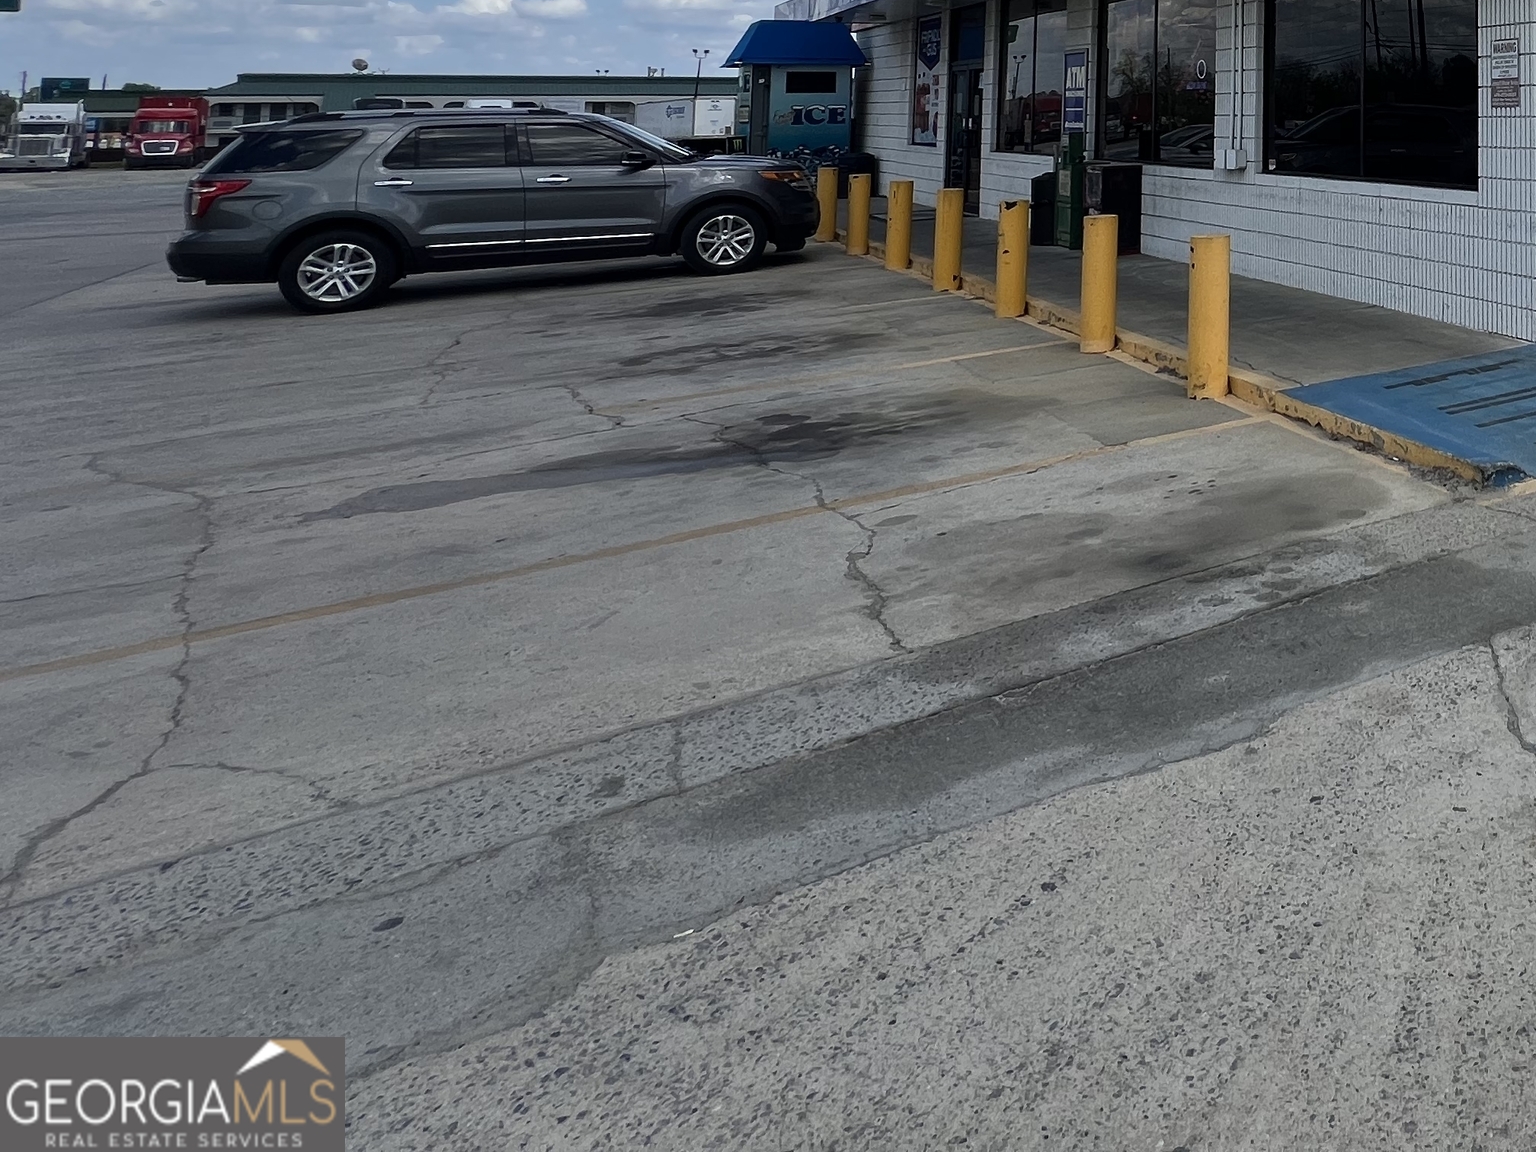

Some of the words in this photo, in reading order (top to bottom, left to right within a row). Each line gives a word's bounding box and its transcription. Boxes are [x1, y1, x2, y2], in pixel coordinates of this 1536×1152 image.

[1493, 42, 1517, 54] WARNING
[1066, 66, 1085, 89] ATM
[790, 104, 847, 126] ICE
